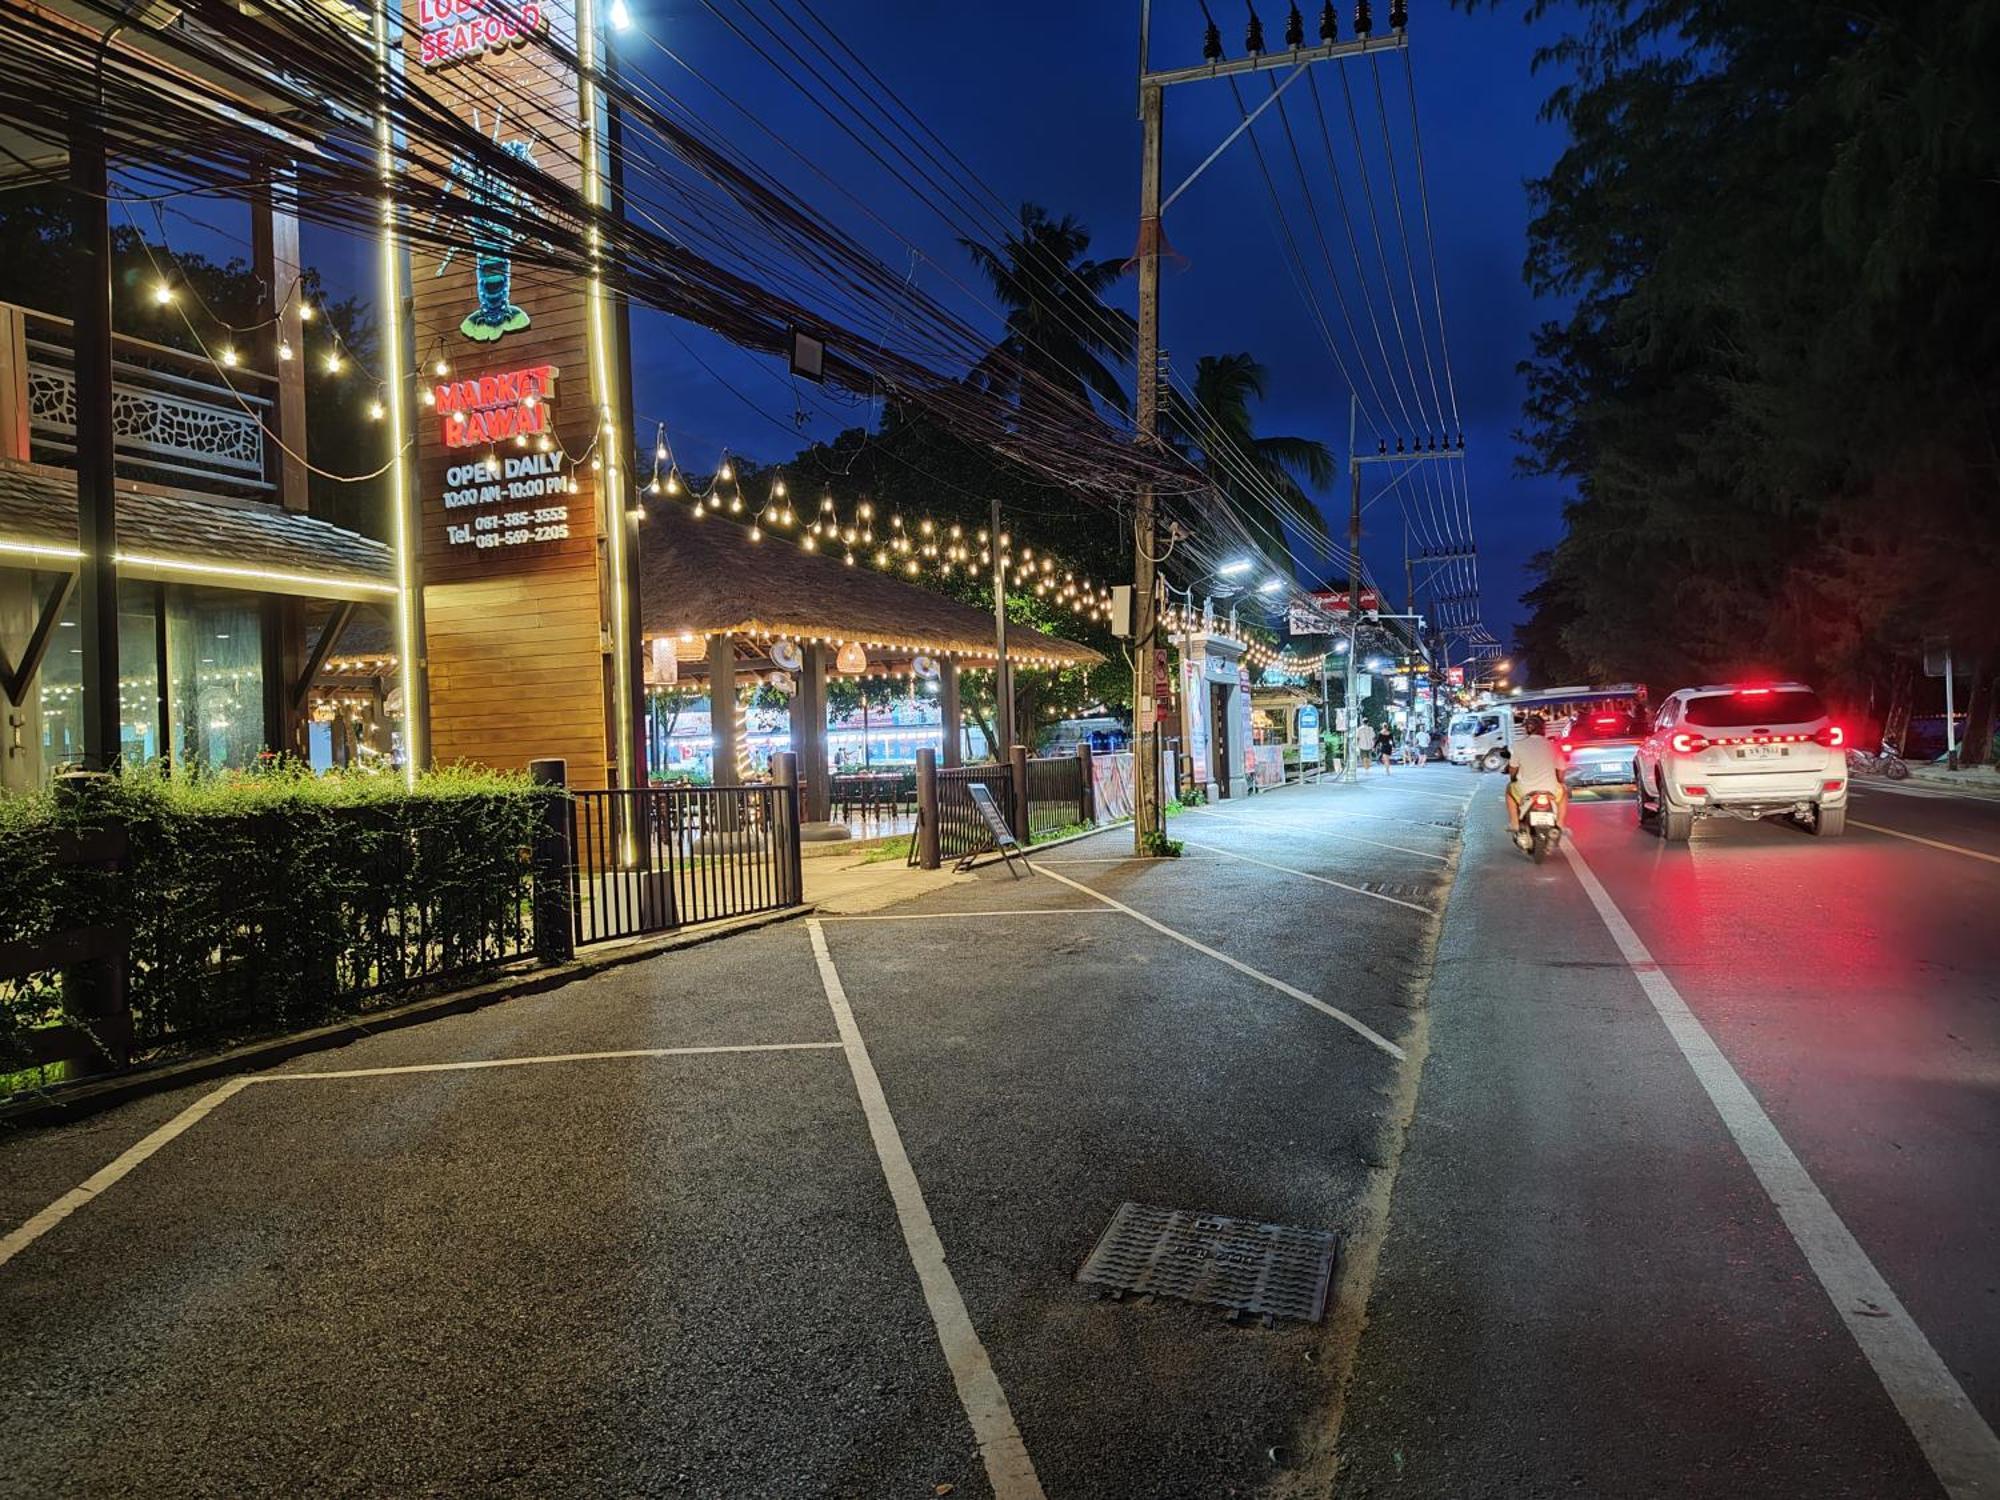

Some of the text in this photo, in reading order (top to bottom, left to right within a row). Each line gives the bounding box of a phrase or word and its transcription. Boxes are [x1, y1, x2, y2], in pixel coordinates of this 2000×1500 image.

[421, 3, 541, 63] SEAFOOD
[436, 365, 559, 415] MARKET
[446, 402, 551, 448] RAWAI
[446, 451, 563, 487] OPEN DAILY
[443, 488, 478, 509] 10:00
[545, 475, 568, 494] PM
[446, 523, 475, 545] Tel.
